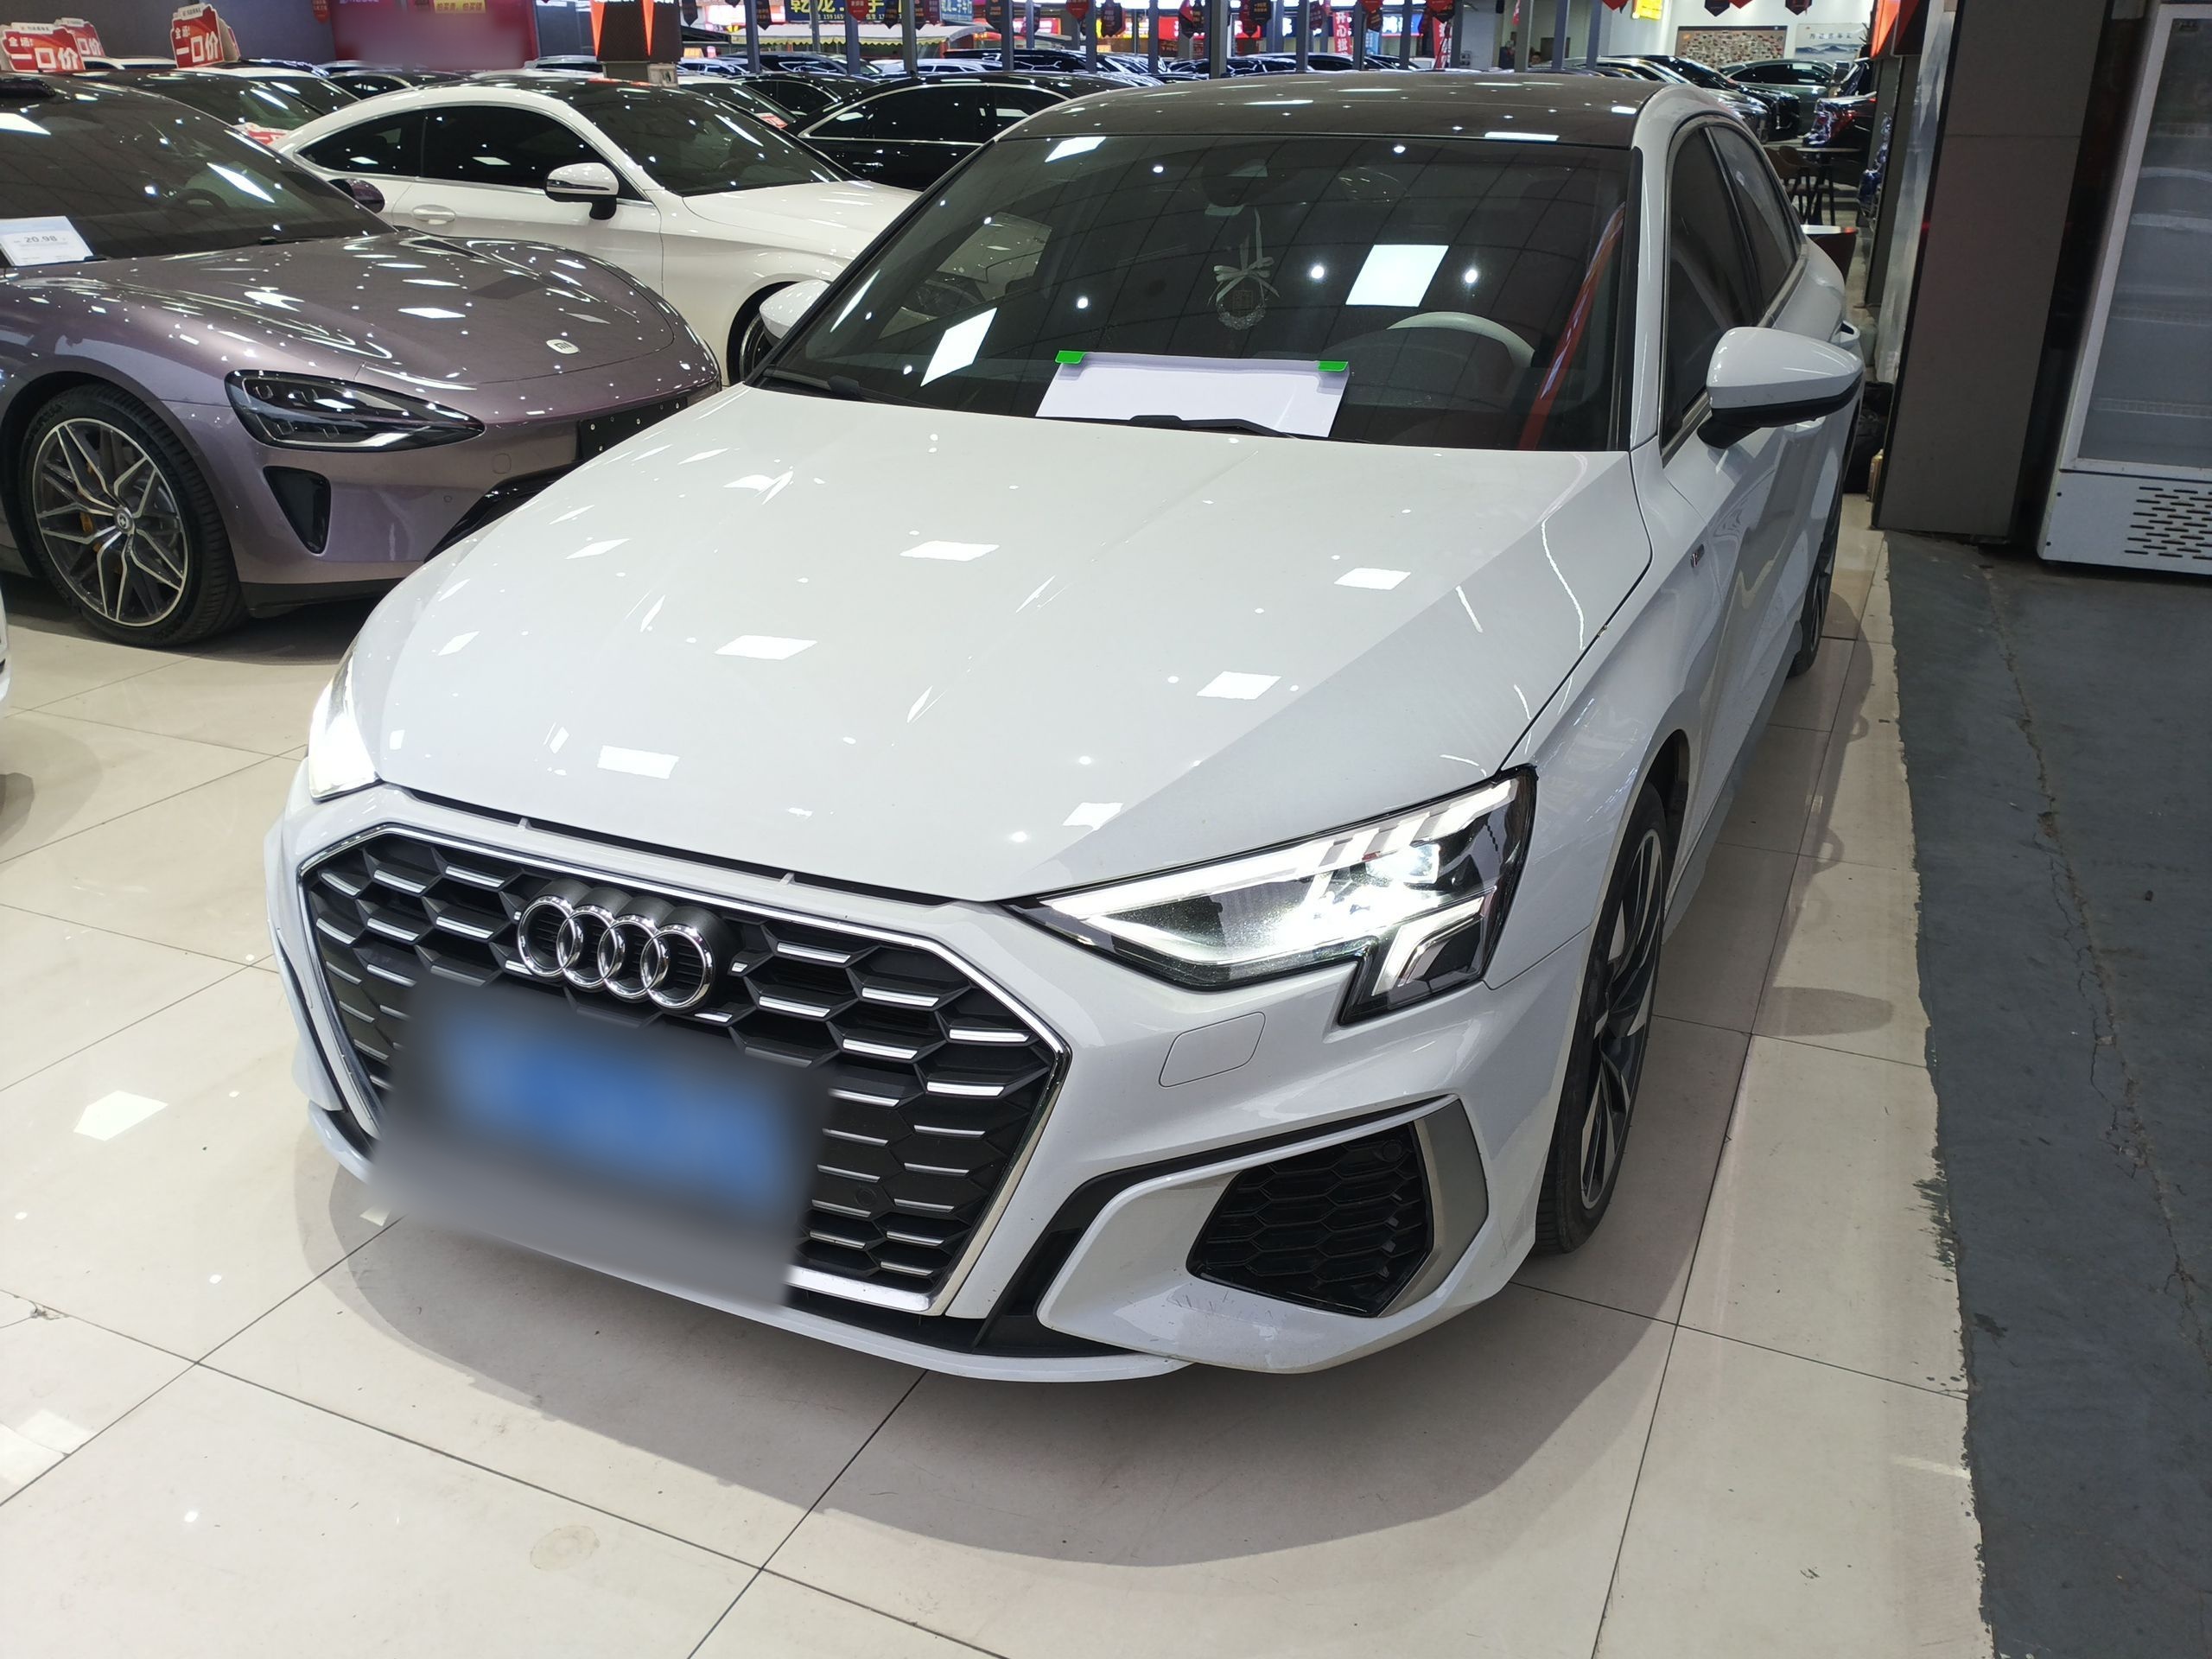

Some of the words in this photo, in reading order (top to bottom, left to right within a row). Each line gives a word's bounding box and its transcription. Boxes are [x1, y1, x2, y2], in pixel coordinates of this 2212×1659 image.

[77, 37, 103, 56] 口价
[175, 30, 219, 63] 一口价
[10, 47, 79, 70] 一口价
